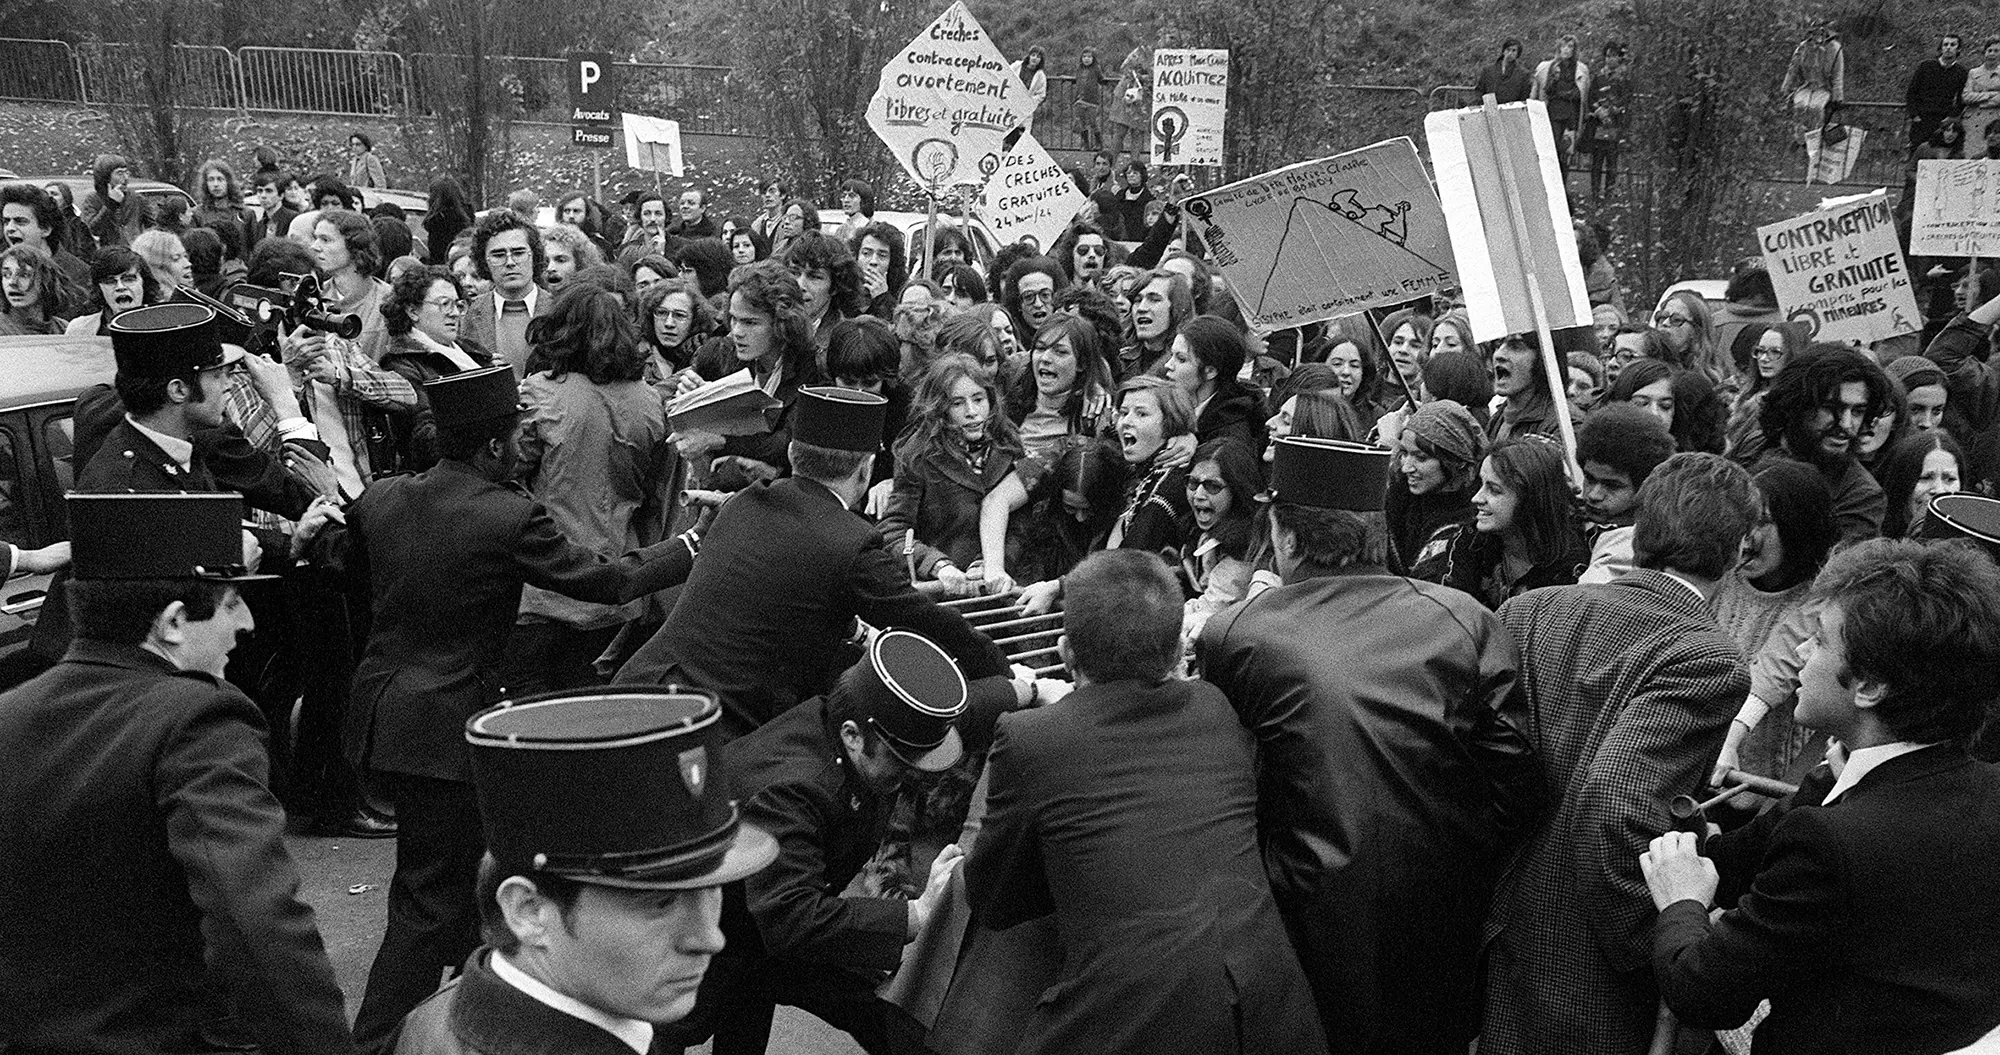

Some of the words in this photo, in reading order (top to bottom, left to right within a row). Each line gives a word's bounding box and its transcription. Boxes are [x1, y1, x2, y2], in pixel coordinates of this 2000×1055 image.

[930, 17, 980, 42] Creches
[581, 61, 600, 93] P
[897, 74, 1010, 99] avortement
[573, 107, 610, 120] Avocats
[886, 96, 930, 122] libres
[932, 108, 946, 120] et
[575, 130, 609, 143] Presse
[1006, 154, 1035, 167] DES
[1005, 165, 1061, 188] CRECHES
[1293, 177, 1333, 192] BONDY
[995, 217, 1012, 229] 24
[1764, 199, 1891, 253] CONTRACEPTION
[1844, 243, 1860, 259] et
[1401, 271, 1450, 292] FEMME
[1809, 252, 1899, 294] GRATUITE
[1861, 283, 1889, 300] pour
[1891, 278, 1907, 289] les
[1823, 298, 1887, 323] MINEURES
